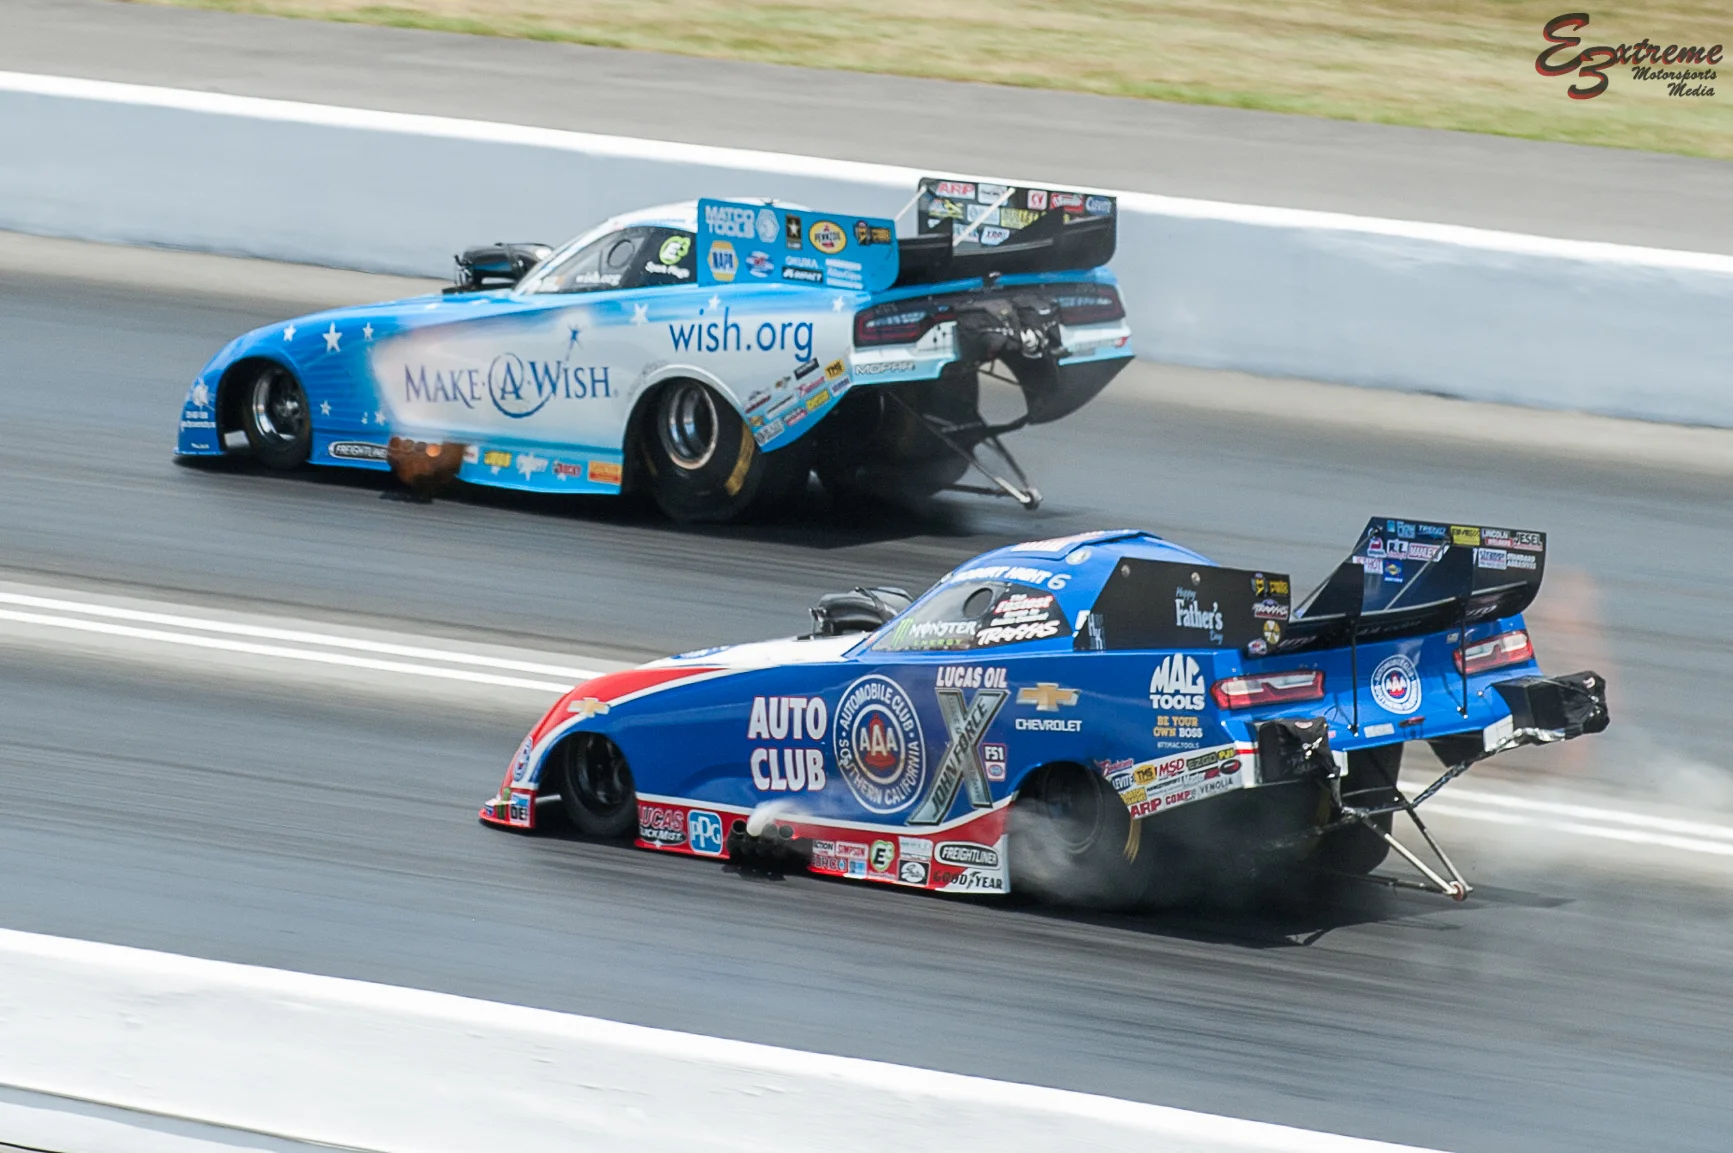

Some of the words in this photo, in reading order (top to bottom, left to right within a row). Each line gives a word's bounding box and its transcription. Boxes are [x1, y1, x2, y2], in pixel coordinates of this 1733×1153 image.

[937, 182, 975, 196] ARP
[704, 205, 755, 224] MATCO
[707, 221, 755, 239] TOOLS
[712, 251, 733, 269] NAPA
[669, 306, 813, 362] wish.org
[855, 362, 914, 376] MOPAR
[1047, 573, 1072, 590] 6
[1175, 586, 1197, 600] Happy
[1175, 599, 1224, 630] Father's
[976, 620, 1061, 646] TRAXXAS
[1209, 630, 1224, 645] Day
[936, 666, 983, 687] LUCAS
[984, 667, 1008, 688] OIL
[1150, 652, 1206, 694] MAC
[839, 682, 893, 731] AUTOMOBILE
[890, 695, 915, 732] CLUB
[1150, 694, 1206, 711] TOOLS
[747, 696, 828, 740] AUTO
[1015, 718, 1083, 732] CHEVROLET
[1157, 716, 1170, 726] BE
[1172, 716, 1199, 727] YOUR
[859, 724, 898, 756] AAA
[1153, 727, 1177, 737] OWN
[1178, 727, 1203, 738] BOSS
[931, 757, 958, 819] JOHN
[954, 697, 988, 764] FORCE
[984, 746, 1005, 760] FS1
[750, 747, 827, 792] CLUB
[884, 740, 921, 806] CALIFORNIA
[1158, 758, 1185, 777] MSD
[1200, 778, 1234, 794] VENOLIA
[1165, 790, 1191, 806] COMP
[1130, 798, 1162, 818] ARP
[690, 816, 721, 848] PPG
[942, 846, 997, 864] FREIGHTLINER
